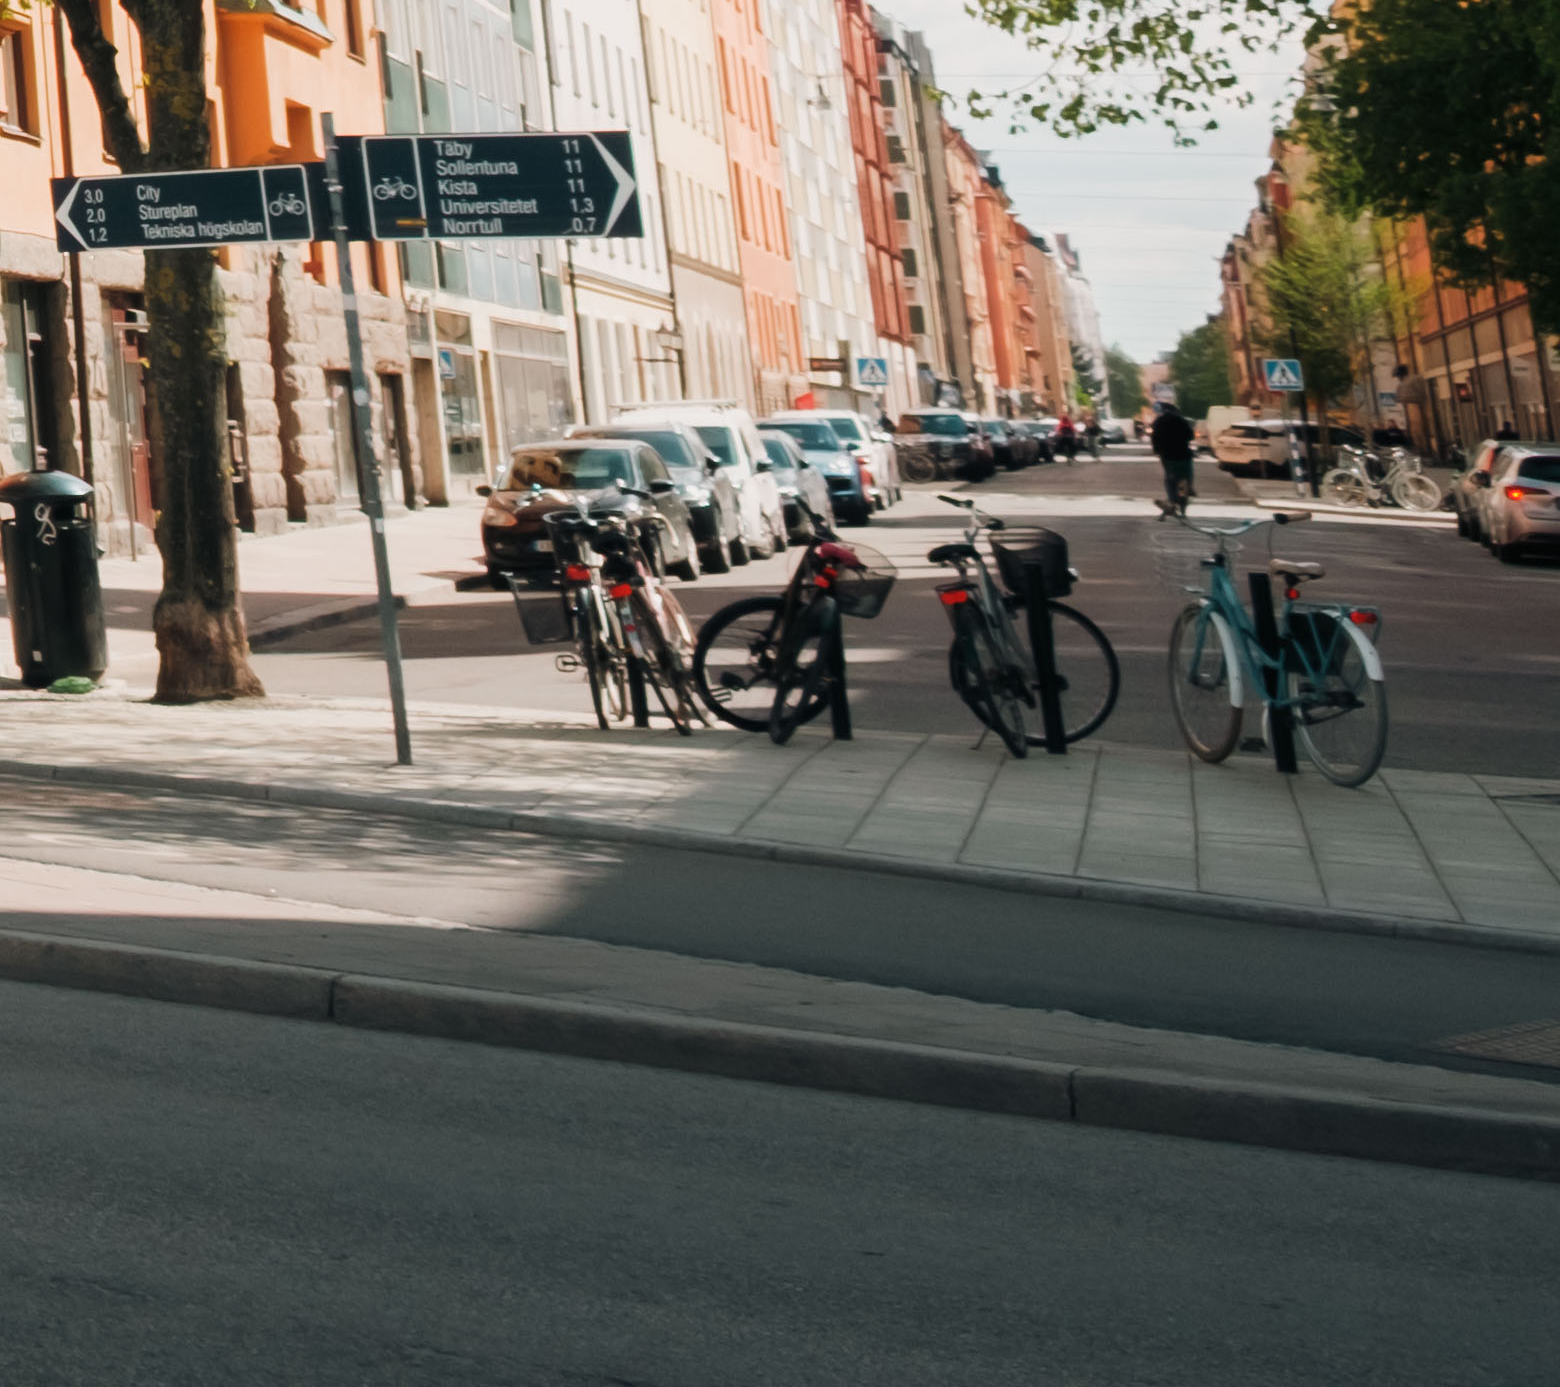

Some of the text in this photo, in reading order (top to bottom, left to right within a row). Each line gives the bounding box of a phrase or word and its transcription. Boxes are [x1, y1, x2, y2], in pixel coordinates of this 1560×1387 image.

[433, 140, 580, 159] Täby 11
[436, 159, 583, 176] Sollentuna 11
[84, 184, 161, 204] 3,0 City
[438, 179, 585, 195] Kista 11
[86, 204, 198, 223] 2,0 Stureplan
[440, 198, 538, 215] Universitetet
[89, 220, 263, 243] 1,2 Tekniska högskolan
[443, 218, 503, 234] Norrtull
